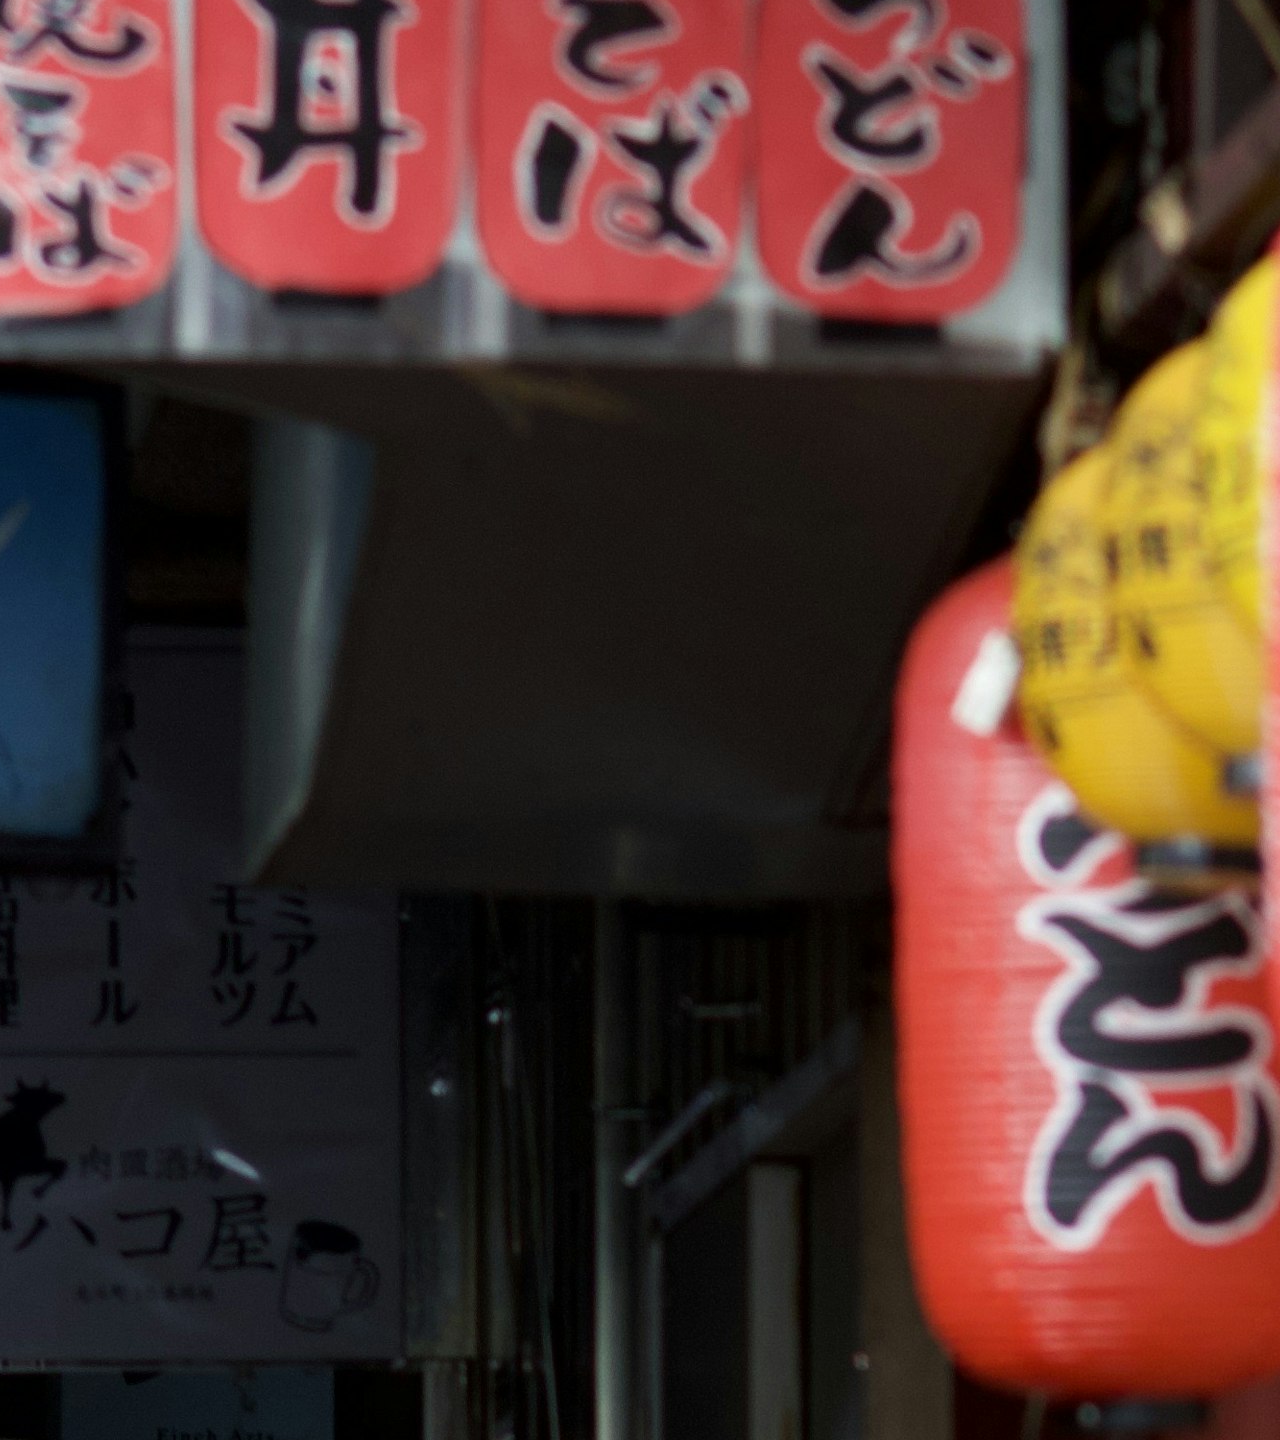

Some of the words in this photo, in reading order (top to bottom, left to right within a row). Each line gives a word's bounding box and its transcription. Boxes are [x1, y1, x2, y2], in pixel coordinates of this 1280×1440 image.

[211, 883, 258, 1027] モルツ
[13, 1193, 277, 1274] ハコ屋
